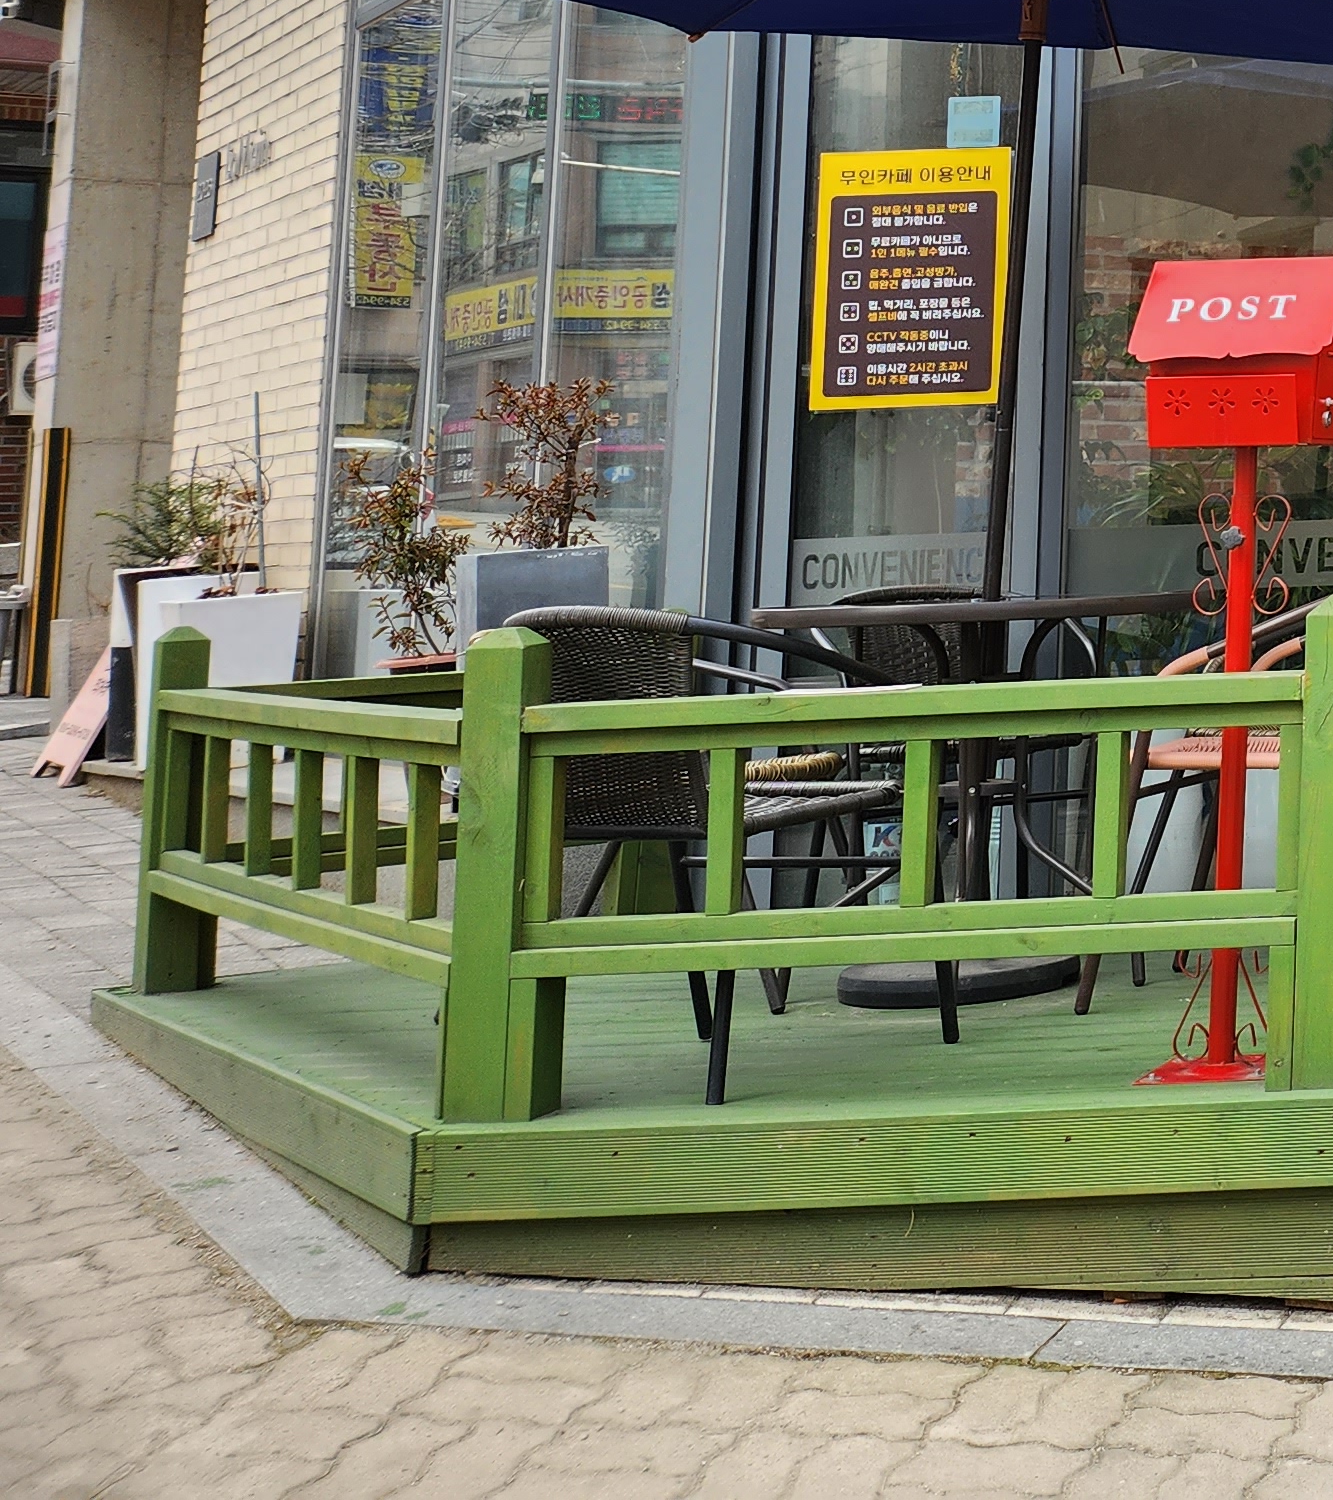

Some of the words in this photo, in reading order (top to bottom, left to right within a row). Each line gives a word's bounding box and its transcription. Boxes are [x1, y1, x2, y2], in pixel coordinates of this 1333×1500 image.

[840, 168, 912, 185] 무인카페
[919, 165, 991, 183] 이용안내
[871, 204, 911, 215] 외부음식
[923, 234, 962, 245] 아니므로
[871, 248, 887, 258] 1인
[1166, 293, 1297, 323] POST
[866, 331, 897, 342] CCTV
[866, 363, 908, 374] 이용시간
[909, 361, 936, 372] 2시간
[938, 360, 968, 372] 초과시
[866, 374, 887, 385] 다시
[802, 546, 984, 591] CONVENIENC
